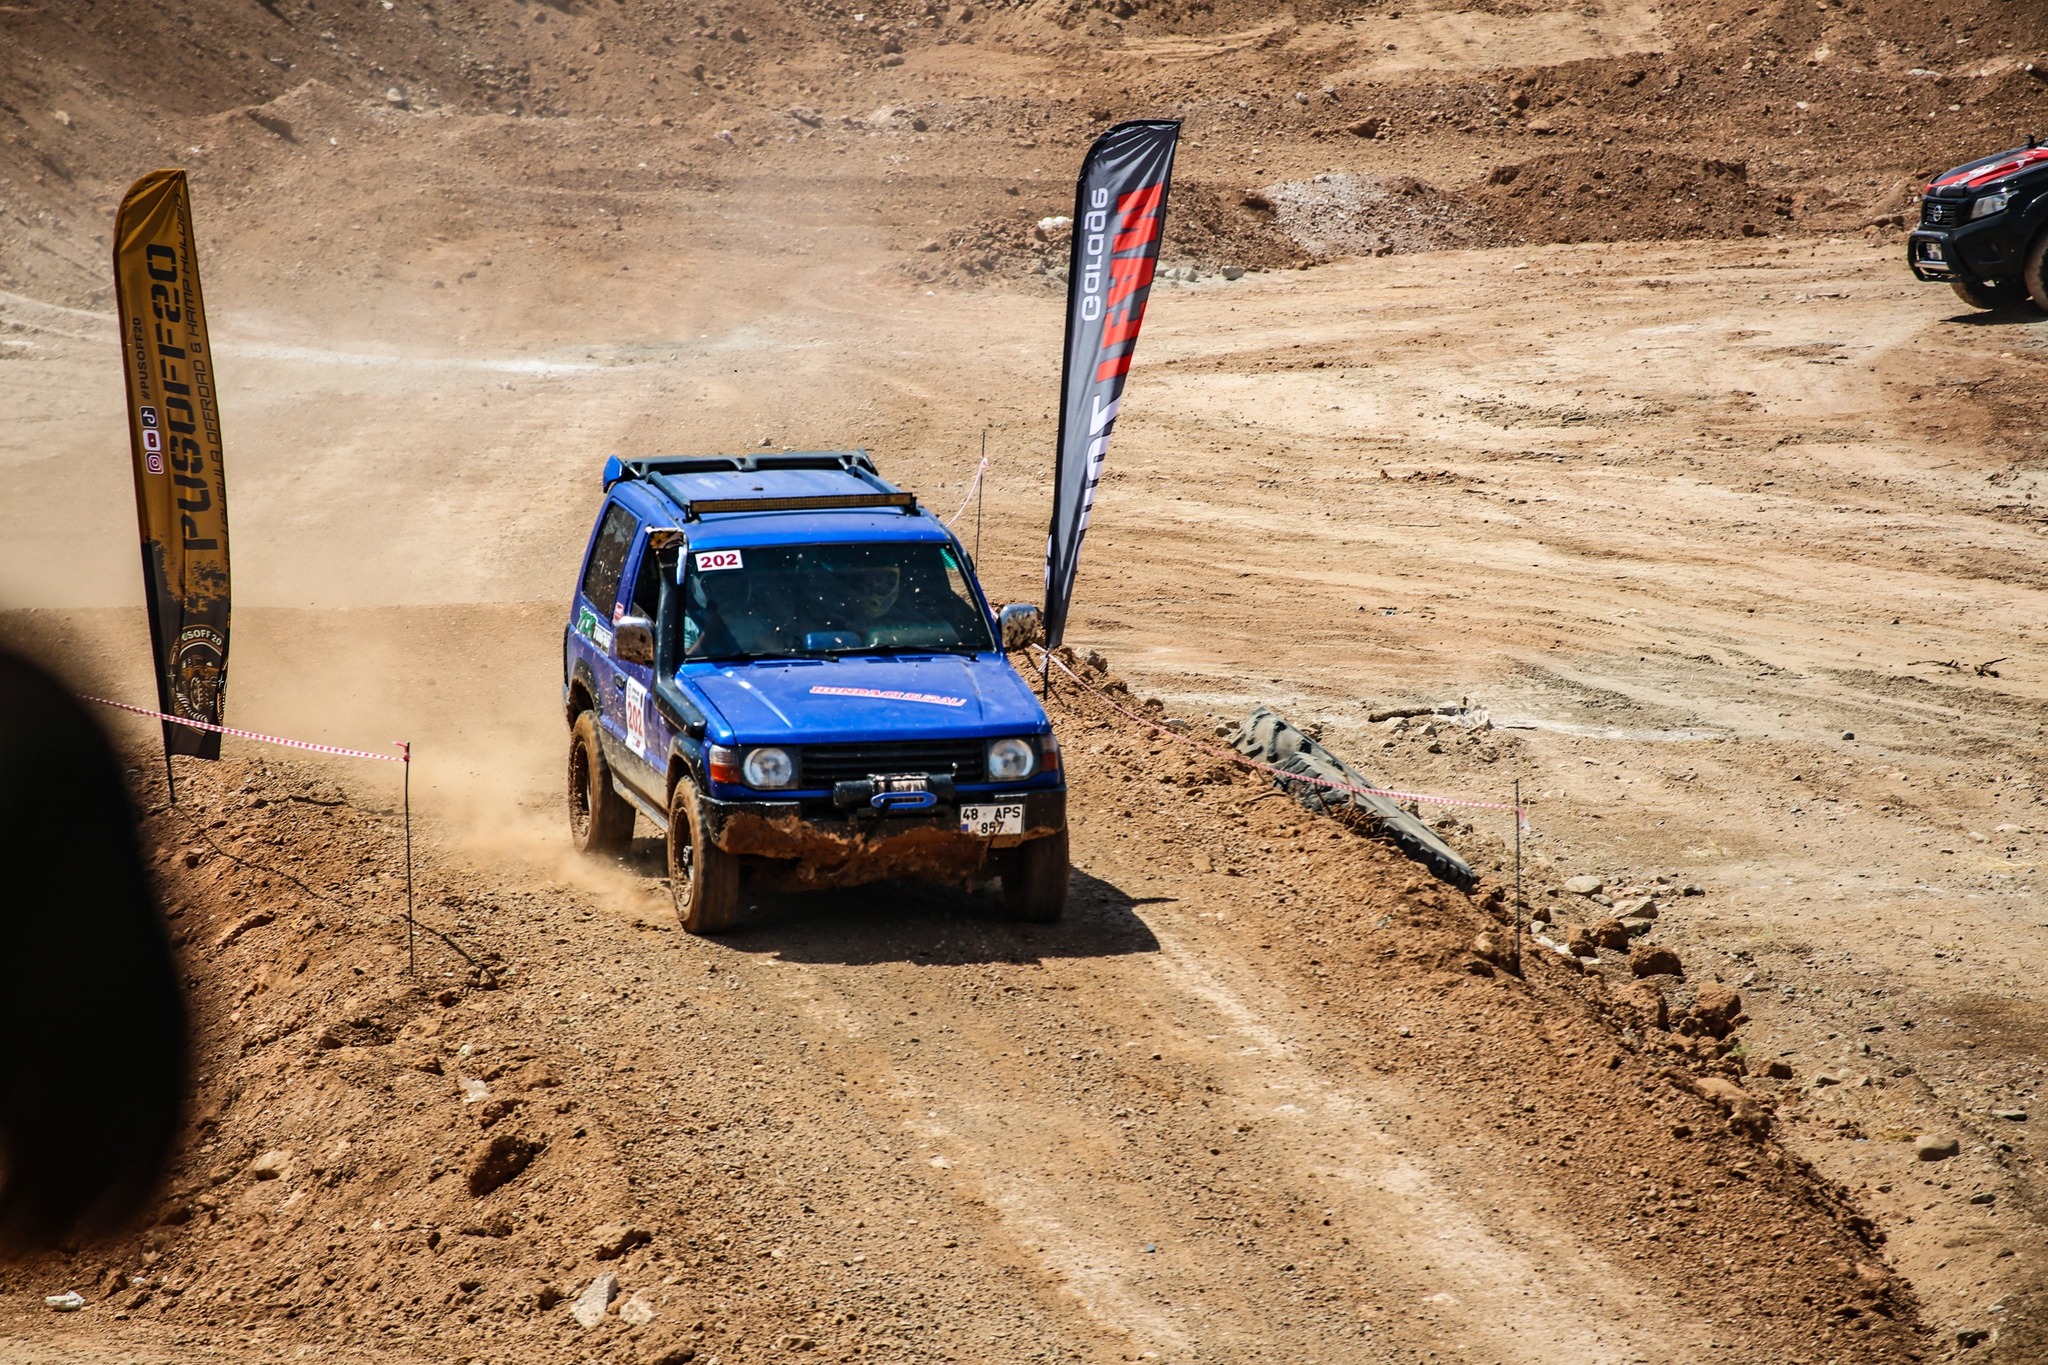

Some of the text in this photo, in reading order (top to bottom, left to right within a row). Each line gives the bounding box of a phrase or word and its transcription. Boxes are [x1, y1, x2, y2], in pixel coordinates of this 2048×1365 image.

[132, 317, 151, 400] #PUSOFF20
[146, 243, 218, 551] PUSOFF20
[193, 359, 219, 446] OFFROAD
[700, 553, 738, 568] 202
[627, 701, 643, 738] 202
[963, 806, 1021, 820] 48 APS
[981, 821, 1005, 834] 857
